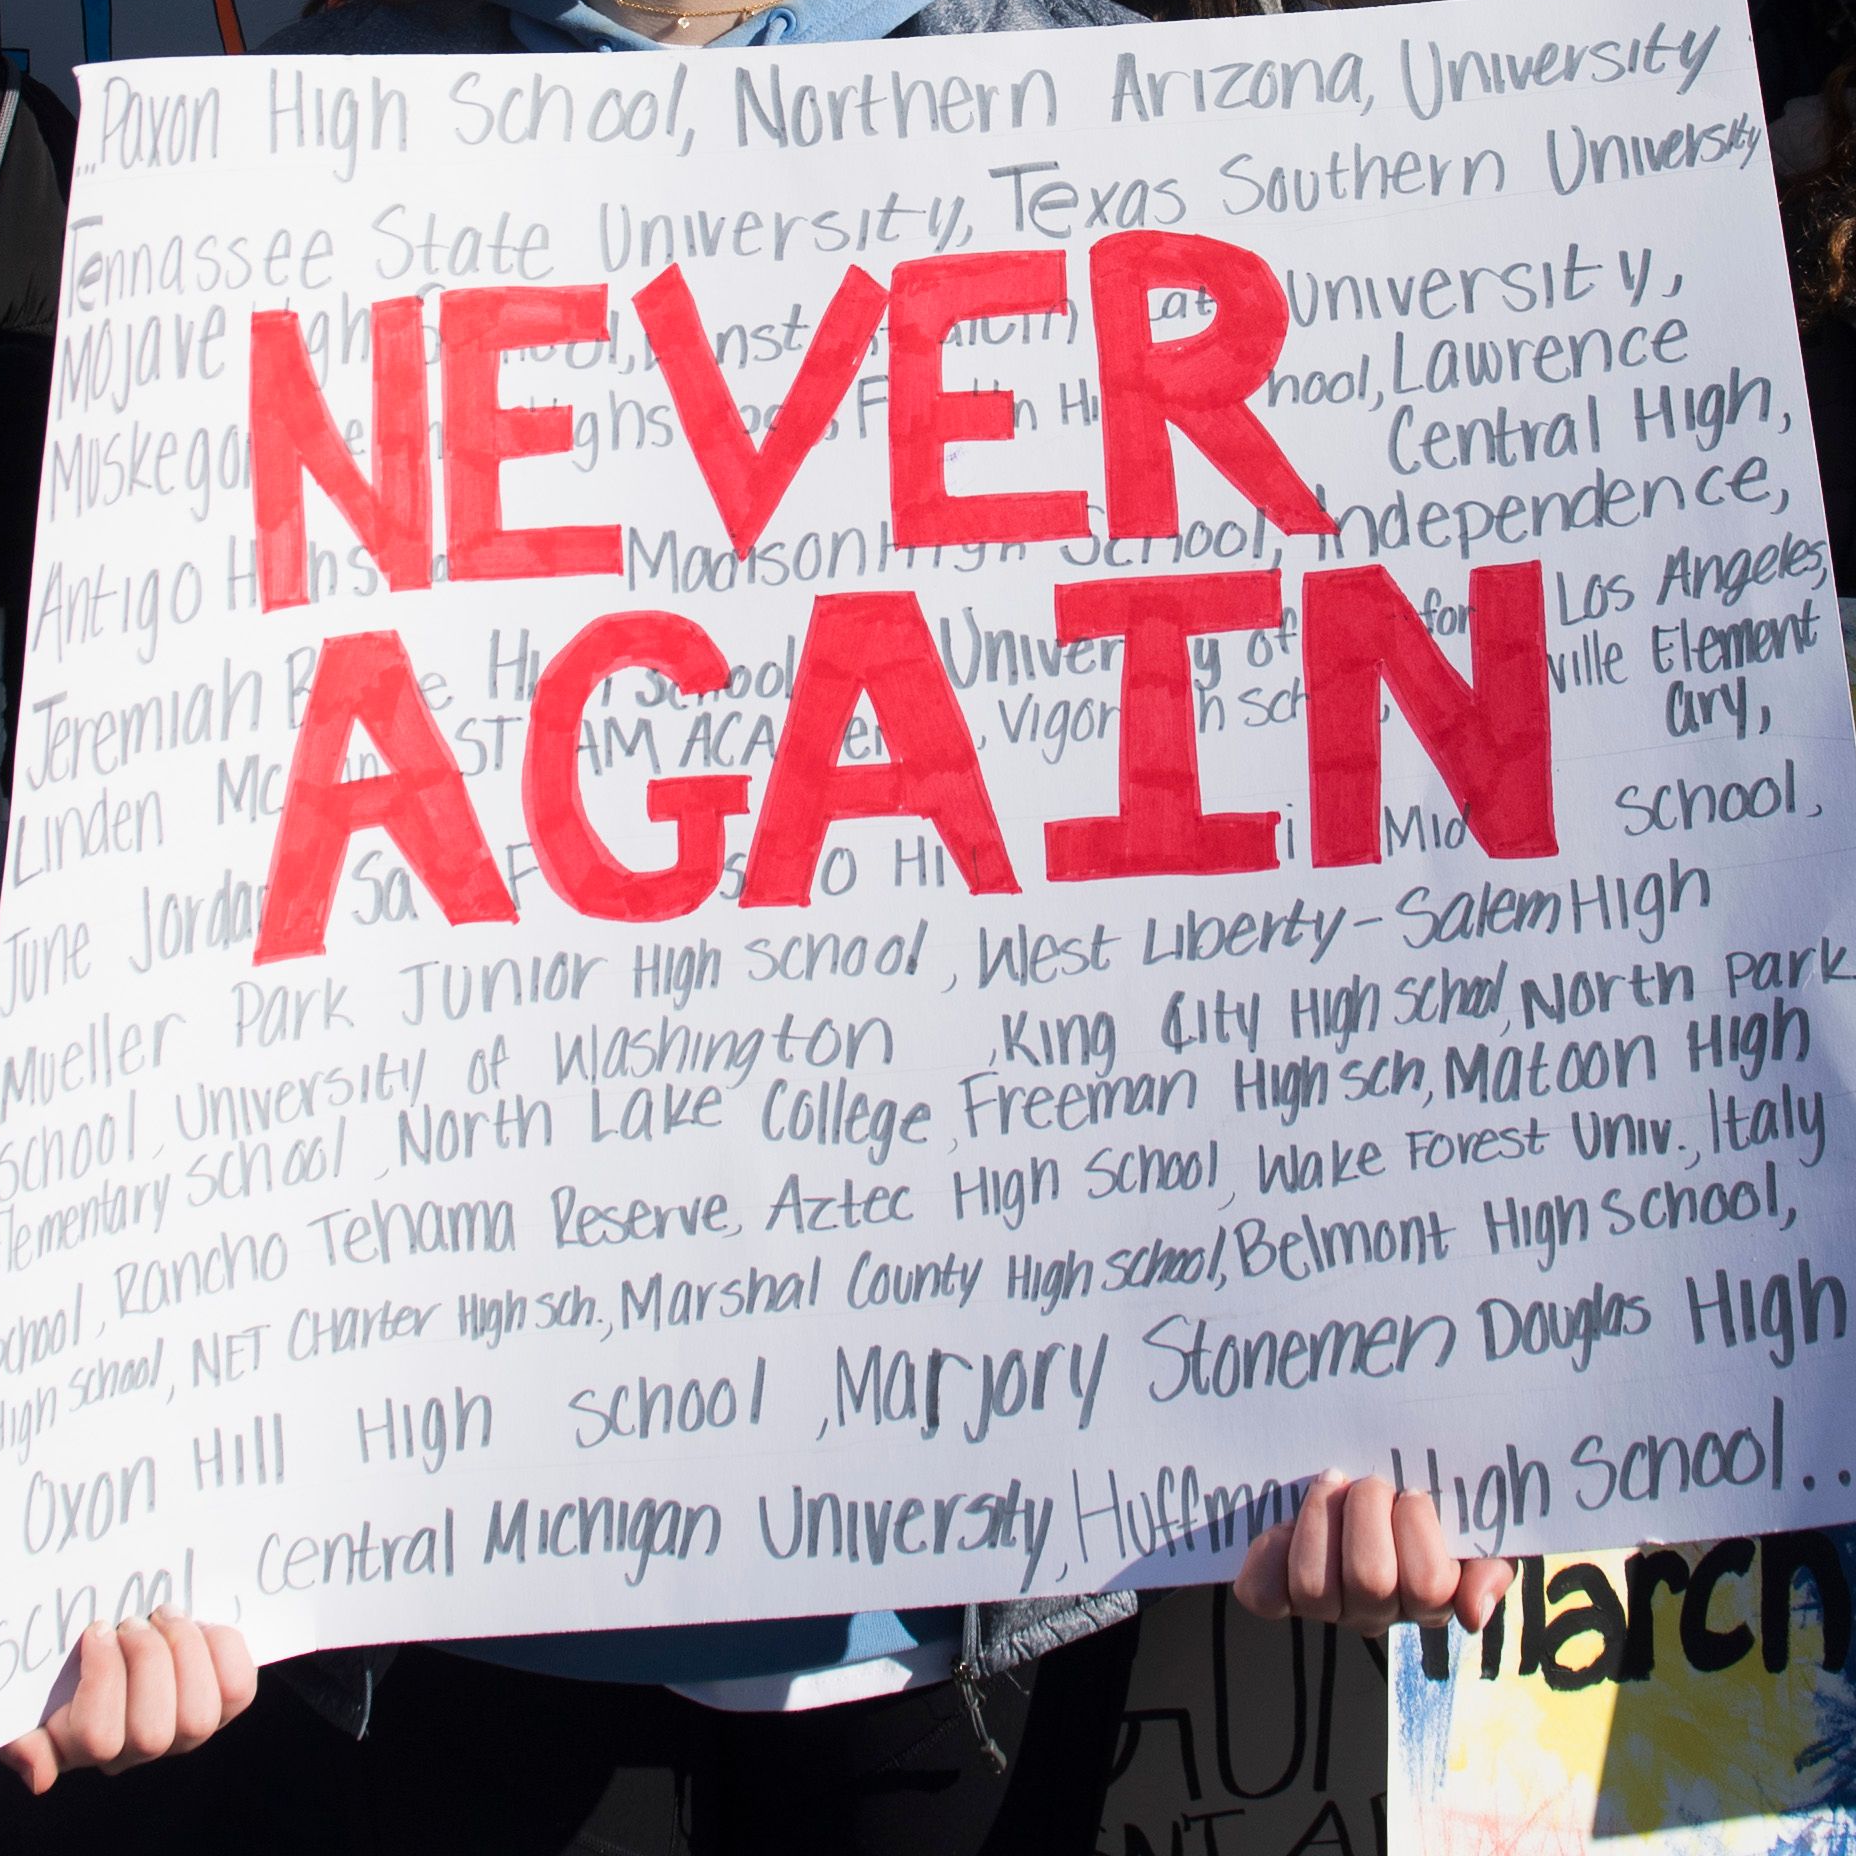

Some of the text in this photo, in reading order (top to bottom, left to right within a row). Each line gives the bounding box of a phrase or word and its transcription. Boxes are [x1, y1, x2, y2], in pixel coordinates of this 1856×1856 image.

[269, 68, 407, 181] High
[450, 60, 696, 156] School,
[735, 62, 1057, 150] Northern
[1111, 50, 1373, 123] Arizona,
[1400, 22, 1720, 120] University
[67, 112, 1761, 318] Tennassee State University, Texas Southern University
[1287, 243, 1682, 330] University,
[58, 305, 225, 420] Mojave
[248, 229, 1341, 614] NEVER
[1388, 366, 1791, 476] Central High,
[1392, 317, 1687, 395] Lawrence
[31, 558, 202, 662] Antigo
[1556, 532, 1827, 626] Los Angeles,
[25, 657, 262, 791] Jeremiah
[252, 558, 1559, 967] AGAIN
[12, 787, 163, 889] Linden
[1, 1011, 182, 1122] Mueller
[231, 975, 353, 1048] Park
[399, 950, 608, 1027] Junior
[631, 938, 720, 1010] High
[977, 923, 1121, 990] West
[1570, 859, 1709, 941] High
[175, 1045, 426, 1143] University
[466, 1036, 510, 1092] of
[1162, 992, 1258, 1052] City
[1291, 972, 1378, 1057] High
[1523, 958, 1695, 1027] North
[590, 1083, 722, 1142] Lake
[1233, 1057, 1328, 1124] High
[1446, 1034, 1656, 1107] Matoon
[1686, 1000, 1809, 1081] High
[114, 1232, 289, 1318] Rancho
[307, 1198, 516, 1268] Tehama
[553, 1184, 742, 1248] Reserve,
[767, 1173, 914, 1236] Aztec
[952, 1154, 1059, 1234] High
[1259, 1142, 1385, 1197] Wake
[1407, 1116, 1549, 1169] Forest
[1708, 1086, 1826, 1167] Italy
[190, 1322, 270, 1388] NET
[458, 1288, 526, 1343] High
[621, 1255, 820, 1330] Marshal
[846, 1250, 982, 1308] County
[1008, 1249, 1092, 1314] High
[1235, 1219, 1454, 1283] Belmont
[1485, 1193, 1588, 1269] High
[22, 1453, 156, 1556] Oxon
[193, 1412, 284, 1493] Hill
[357, 1384, 492, 1474] High
[1141, 1312, 1457, 1404] Stonemen
[1481, 1286, 1652, 1372] Douglas
[1686, 1258, 1848, 1369] High
[257, 1507, 454, 1597] Central
[483, 1496, 721, 1586] Michigan
[1391, 1447, 1549, 1558] High
